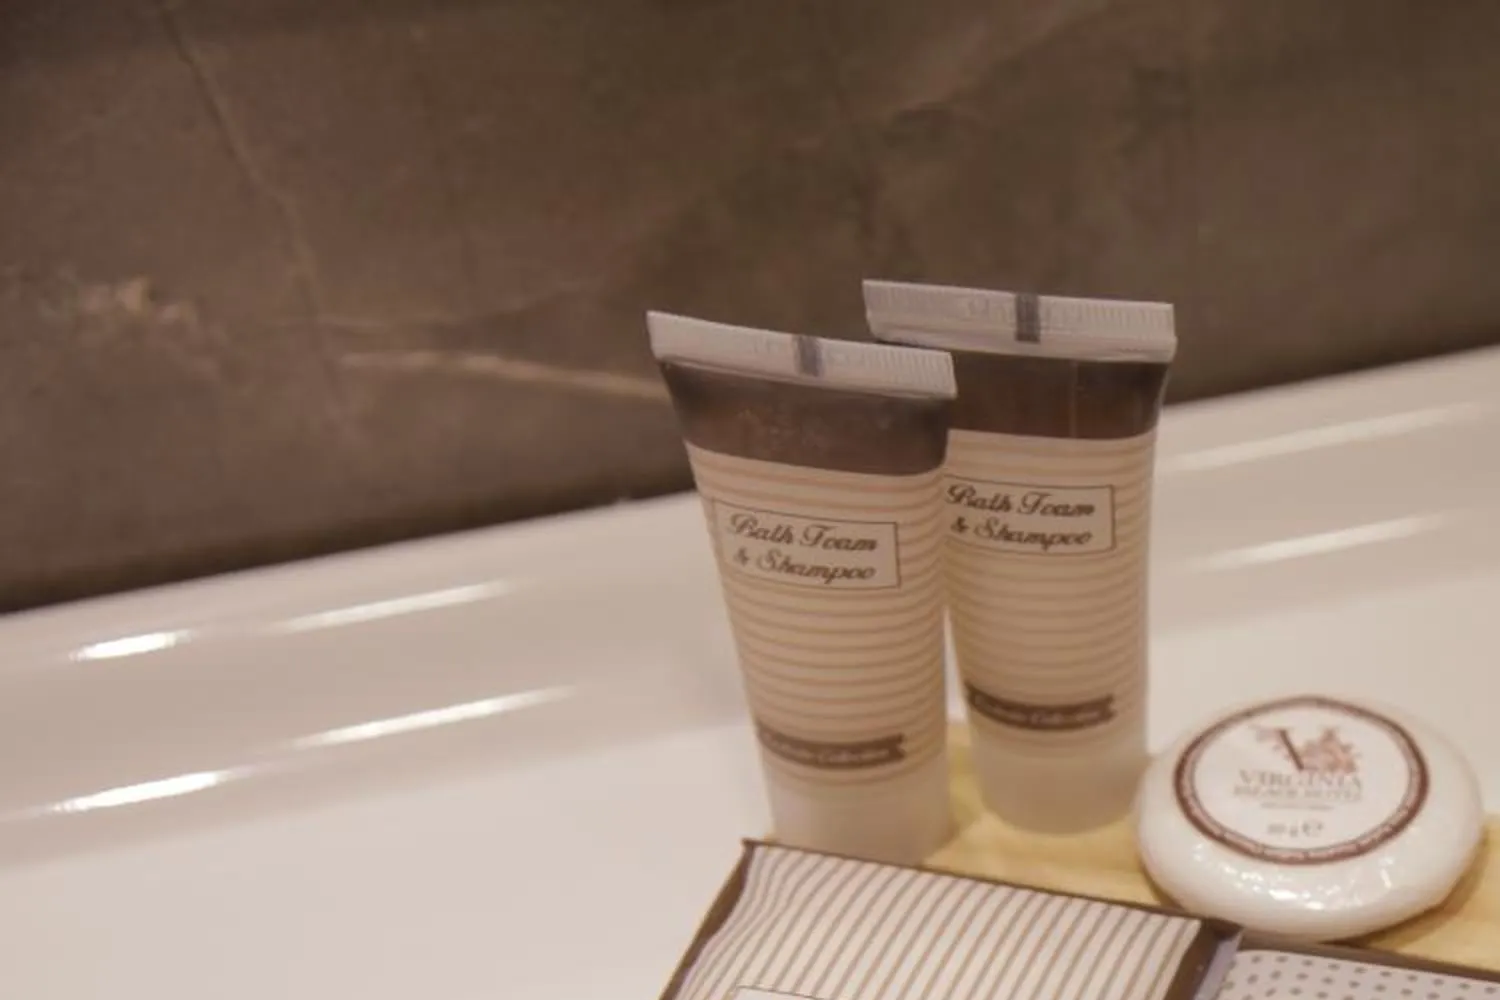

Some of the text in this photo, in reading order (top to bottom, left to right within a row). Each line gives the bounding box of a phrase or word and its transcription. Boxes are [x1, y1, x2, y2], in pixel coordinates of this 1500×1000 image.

[947, 484, 1095, 518] Bath Foam
[730, 512, 878, 552] Bath Foam
[951, 516, 1092, 551] & Shampoo
[732, 548, 876, 584] & Shampoo
